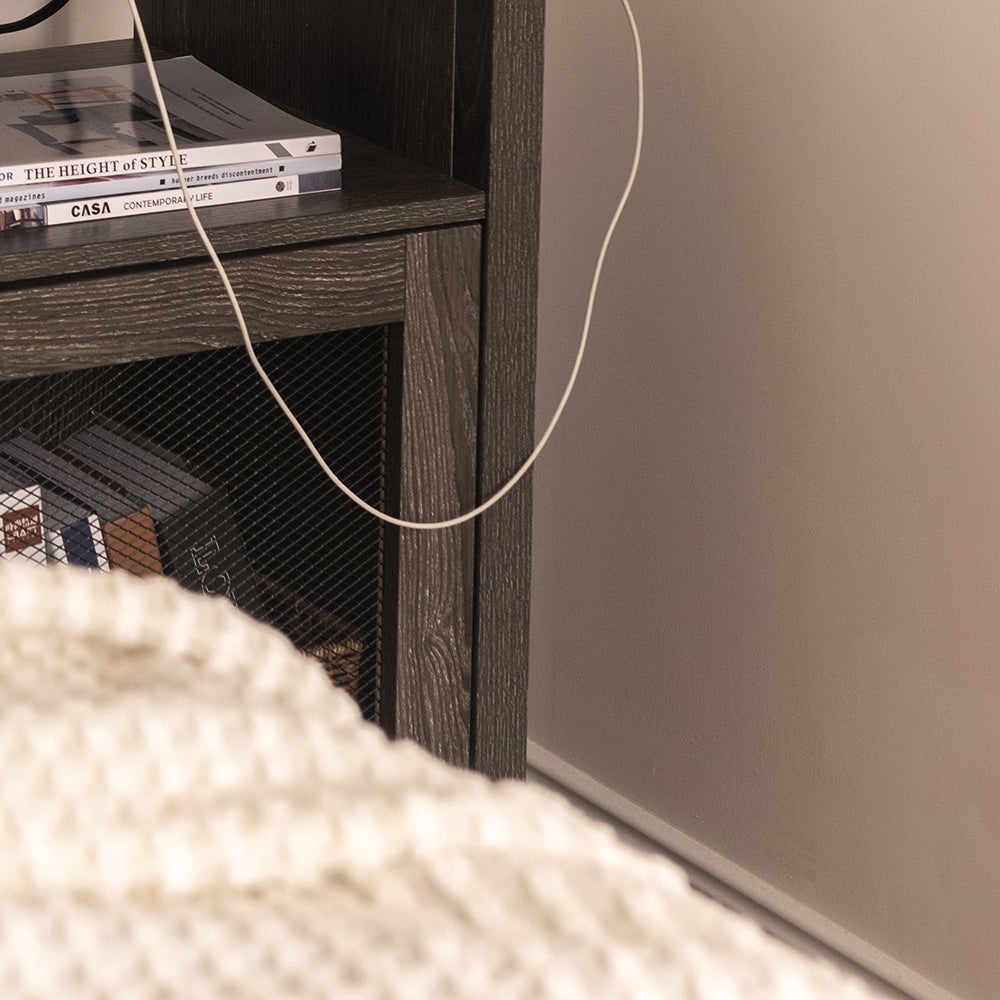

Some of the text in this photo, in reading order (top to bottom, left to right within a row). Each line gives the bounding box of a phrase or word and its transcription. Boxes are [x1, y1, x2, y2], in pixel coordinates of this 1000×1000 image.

[24, 166, 55, 180] THE
[59, 159, 120, 177] HEIGHT
[123, 158, 138, 171] of
[140, 153, 188, 169] STYLE
[172, 166, 273, 185] huer breeds discontentment
[4, 192, 46, 204] magazines
[71, 202, 112, 217] CASA
[195, 192, 214, 202] LIFE
